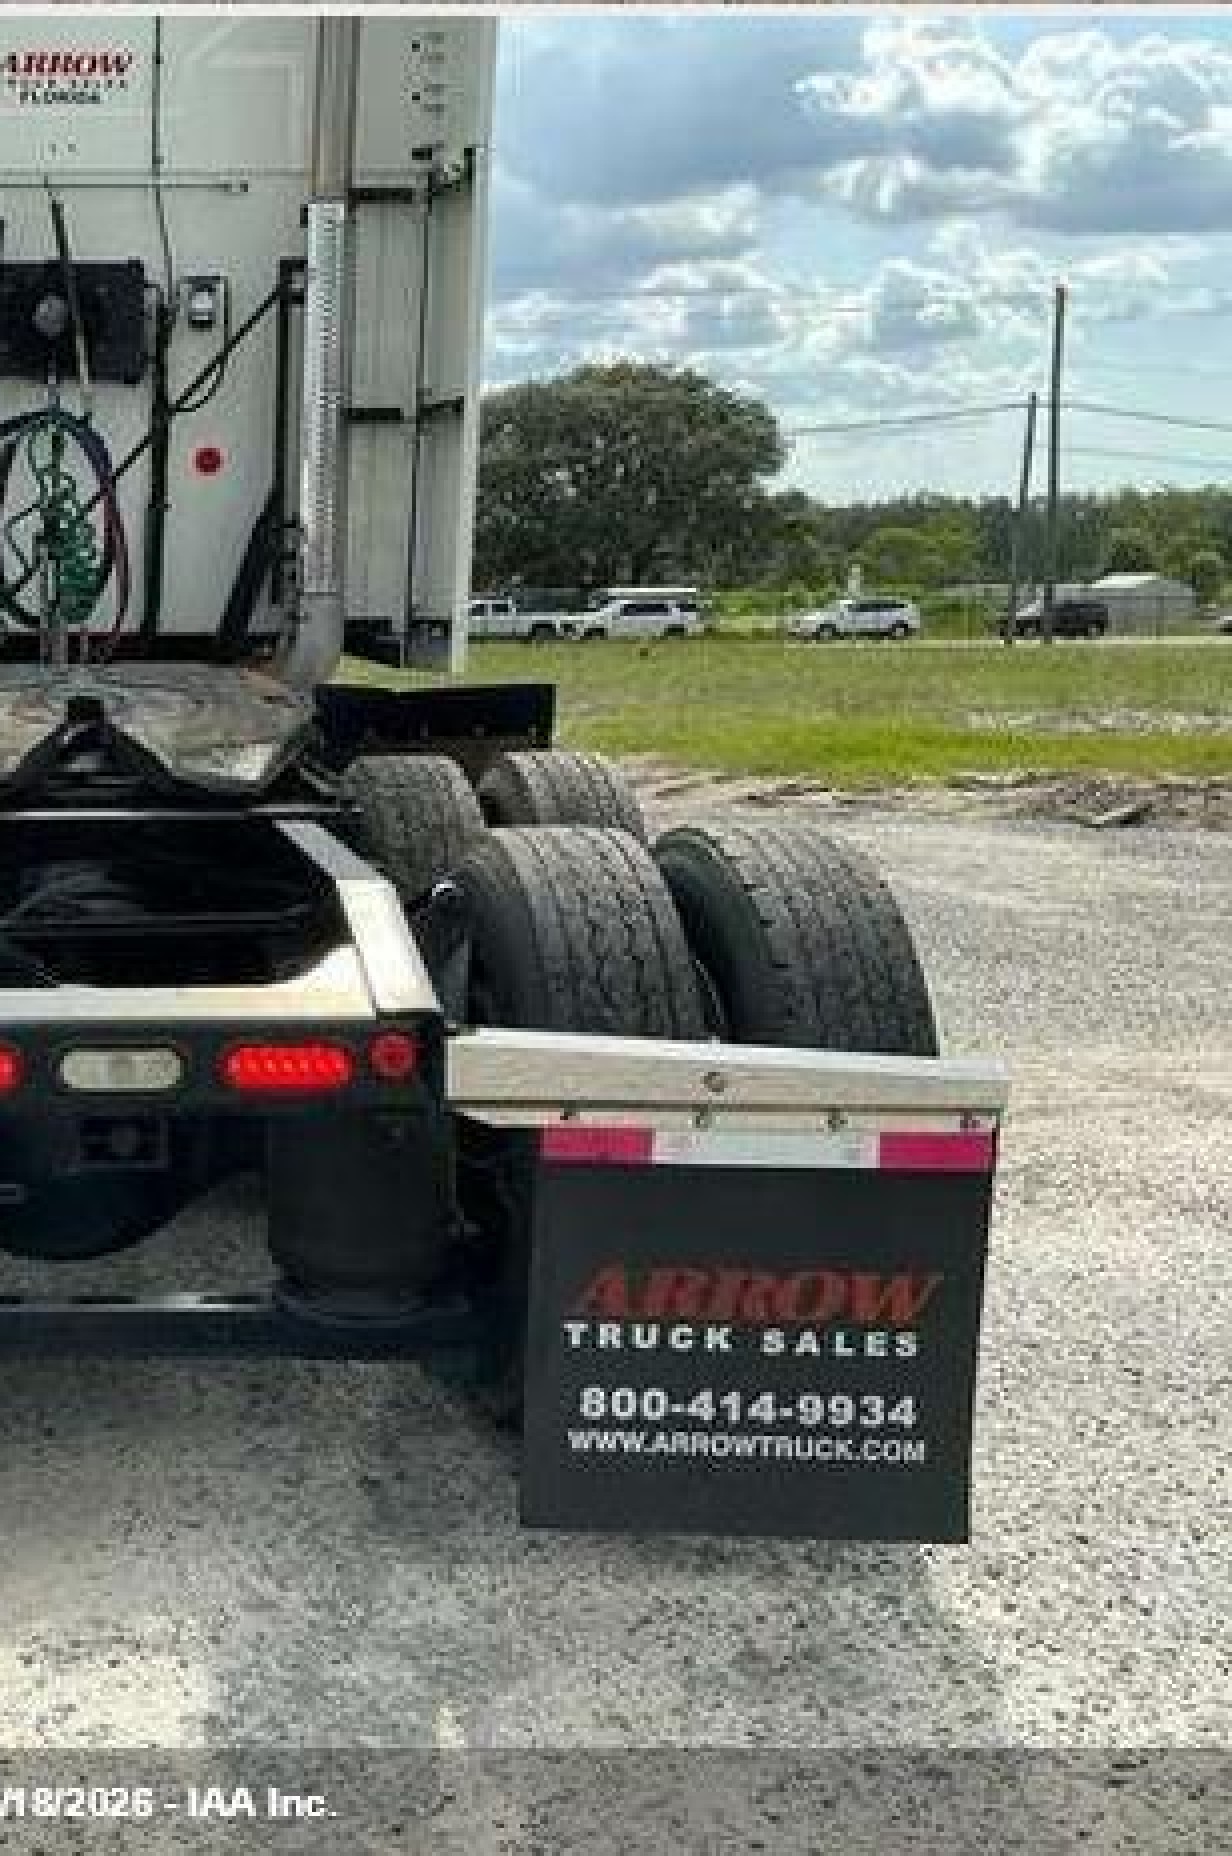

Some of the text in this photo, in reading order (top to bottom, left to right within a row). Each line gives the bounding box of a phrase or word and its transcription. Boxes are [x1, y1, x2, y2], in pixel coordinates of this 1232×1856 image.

[574, 1266, 944, 1324] ARROW
[564, 1322, 918, 1358] TRUCK SALES
[579, 1387, 918, 1428] 800-414-9934
[567, 1429, 926, 1463] WWW.ARROWTRUCK.COM
